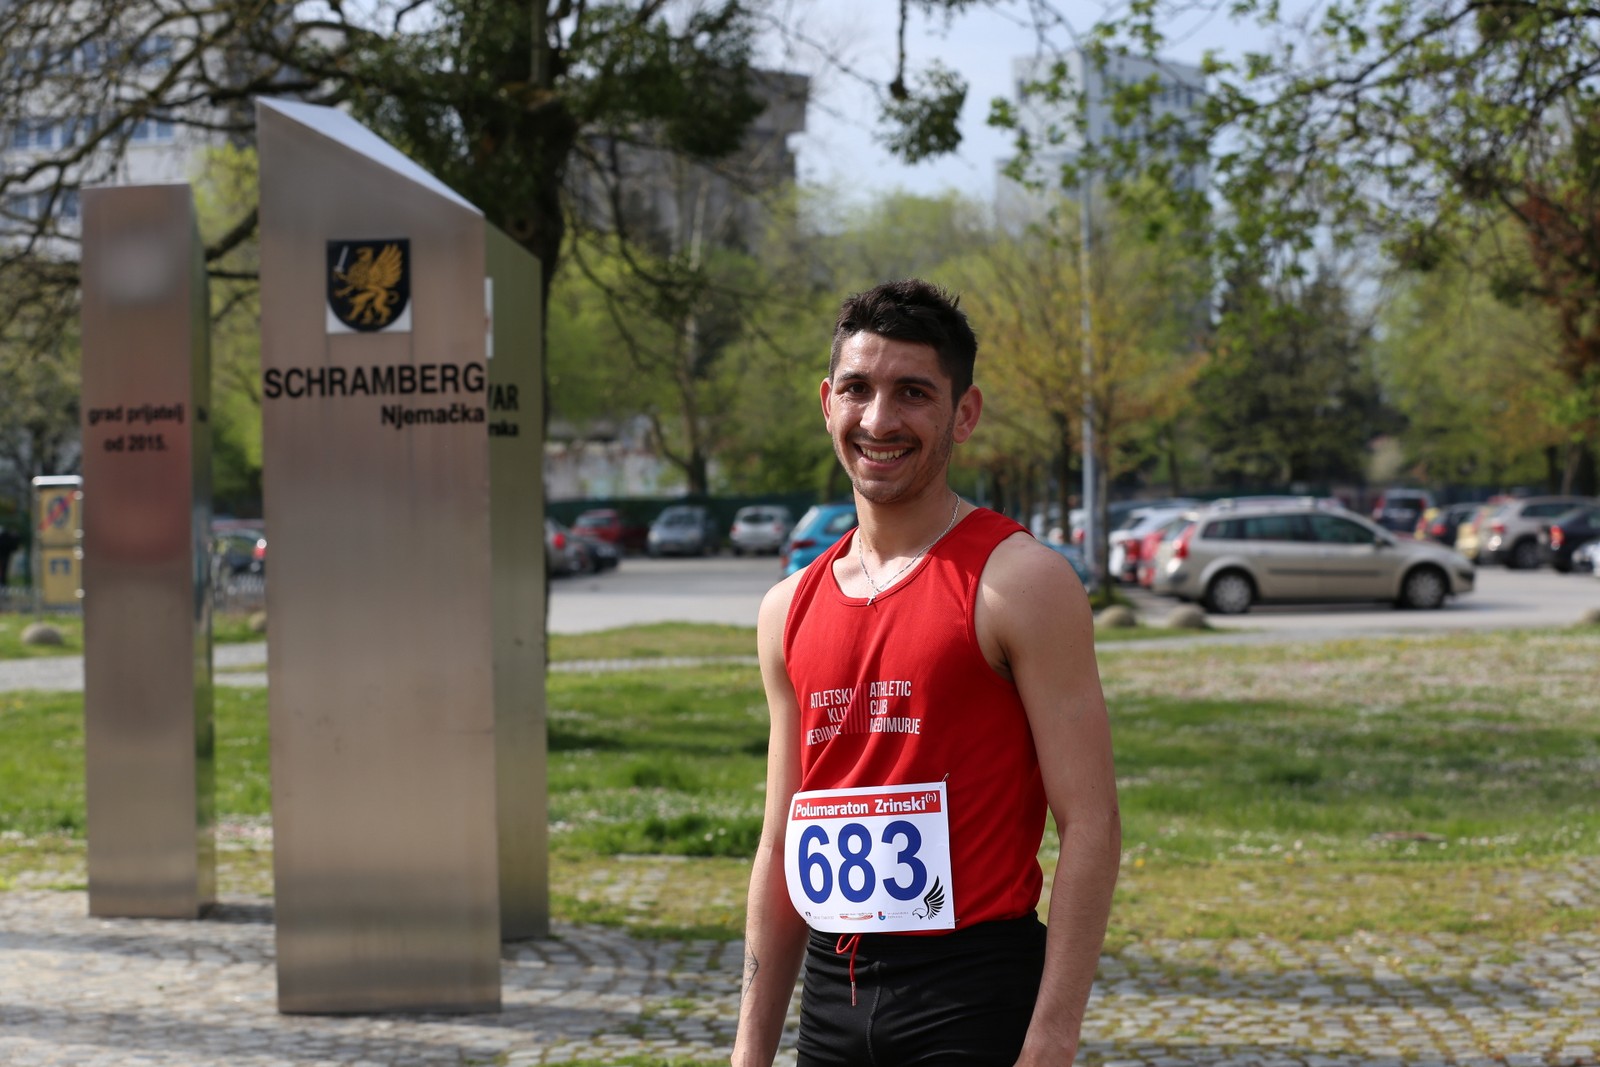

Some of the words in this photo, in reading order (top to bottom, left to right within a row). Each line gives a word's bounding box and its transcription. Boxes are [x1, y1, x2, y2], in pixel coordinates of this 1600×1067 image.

[263, 362, 485, 399] SCHRAMBERG
[88, 405, 123, 426] grad
[127, 403, 184, 425] prijatelj
[381, 403, 485, 430] Njemačka
[103, 434, 124, 452] od
[810, 688, 853, 709] ATLETSKI
[869, 680, 912, 697] ATHLETIC
[869, 699, 888, 715] CLUB
[795, 802, 869, 817] Polumaraton
[798, 820, 928, 904] 683
